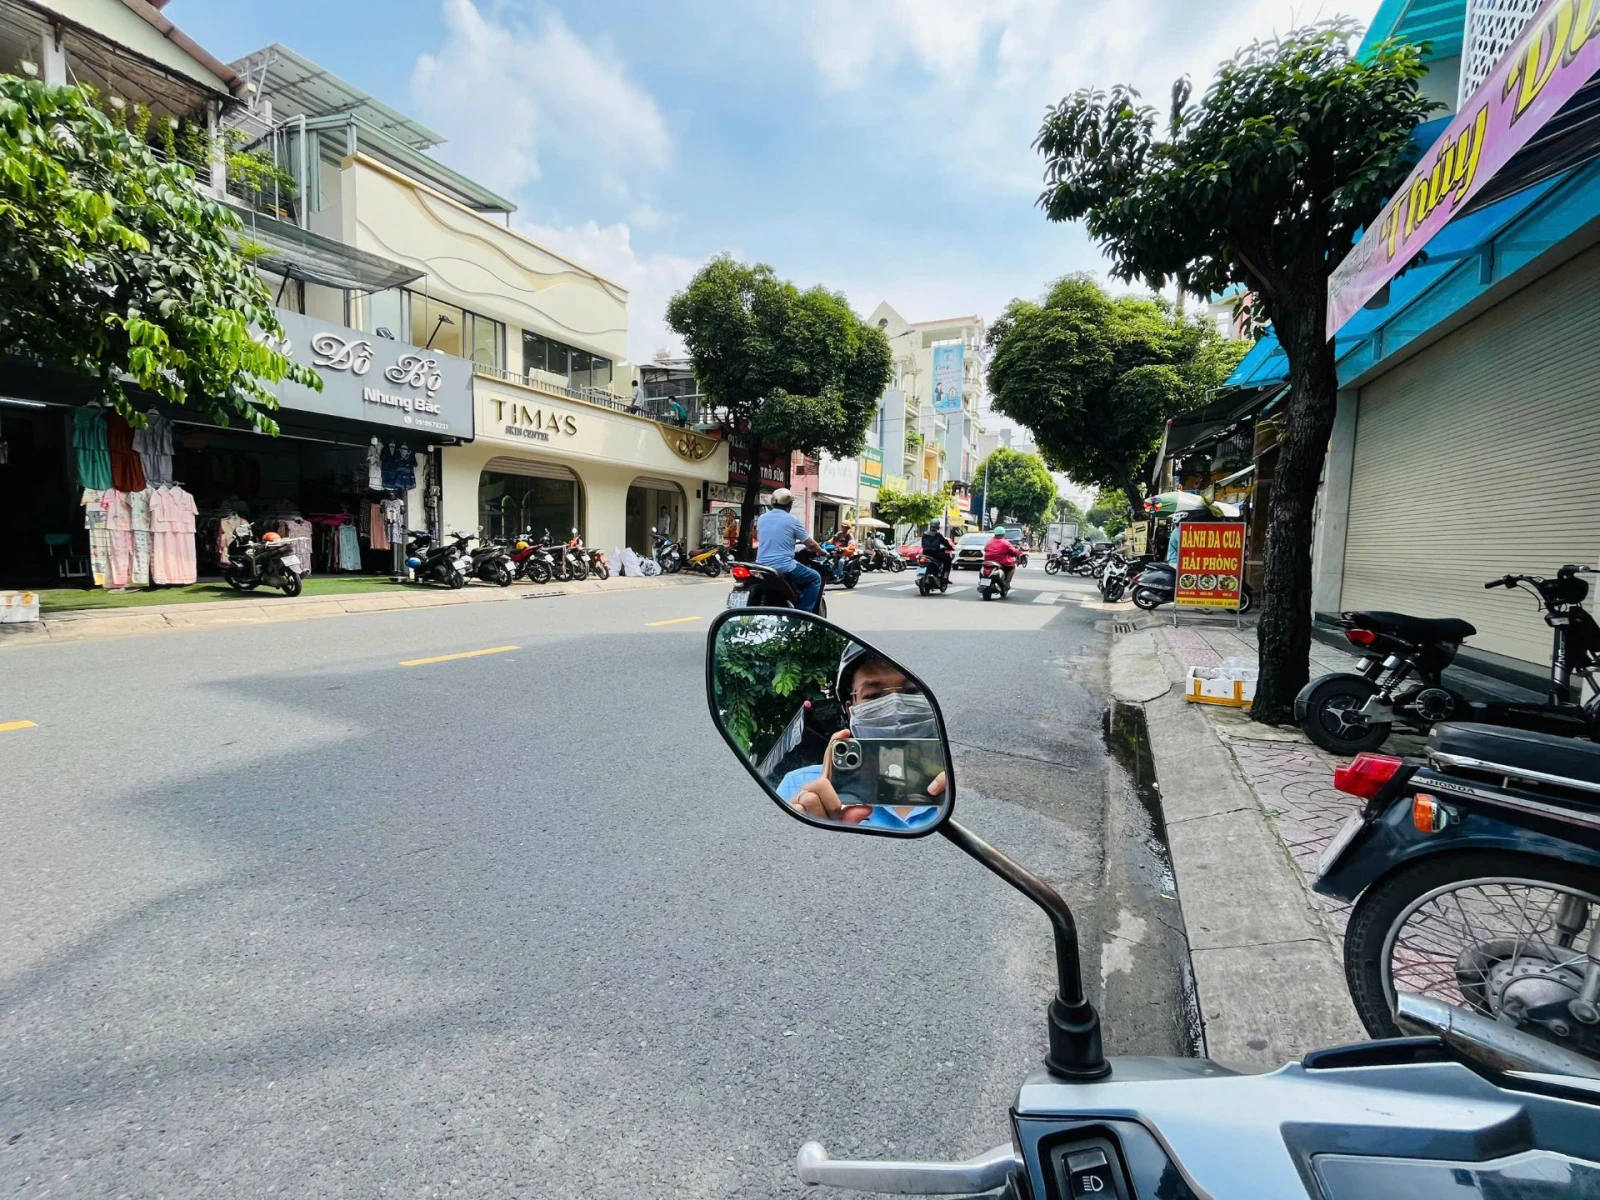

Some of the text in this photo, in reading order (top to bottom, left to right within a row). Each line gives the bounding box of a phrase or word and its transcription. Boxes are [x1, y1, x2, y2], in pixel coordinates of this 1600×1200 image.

[385, 354, 441, 397] Bộ
[363, 387, 412, 412] Nhung
[489, 399, 577, 436] TIMA'S
[505, 425, 549, 441] SKIN CENTER
[1181, 525, 1241, 549] BÁNH ĐA CUA
[1182, 551, 1238, 571] HẢI PHÒNG
[1428, 779, 1476, 795] HONDA
